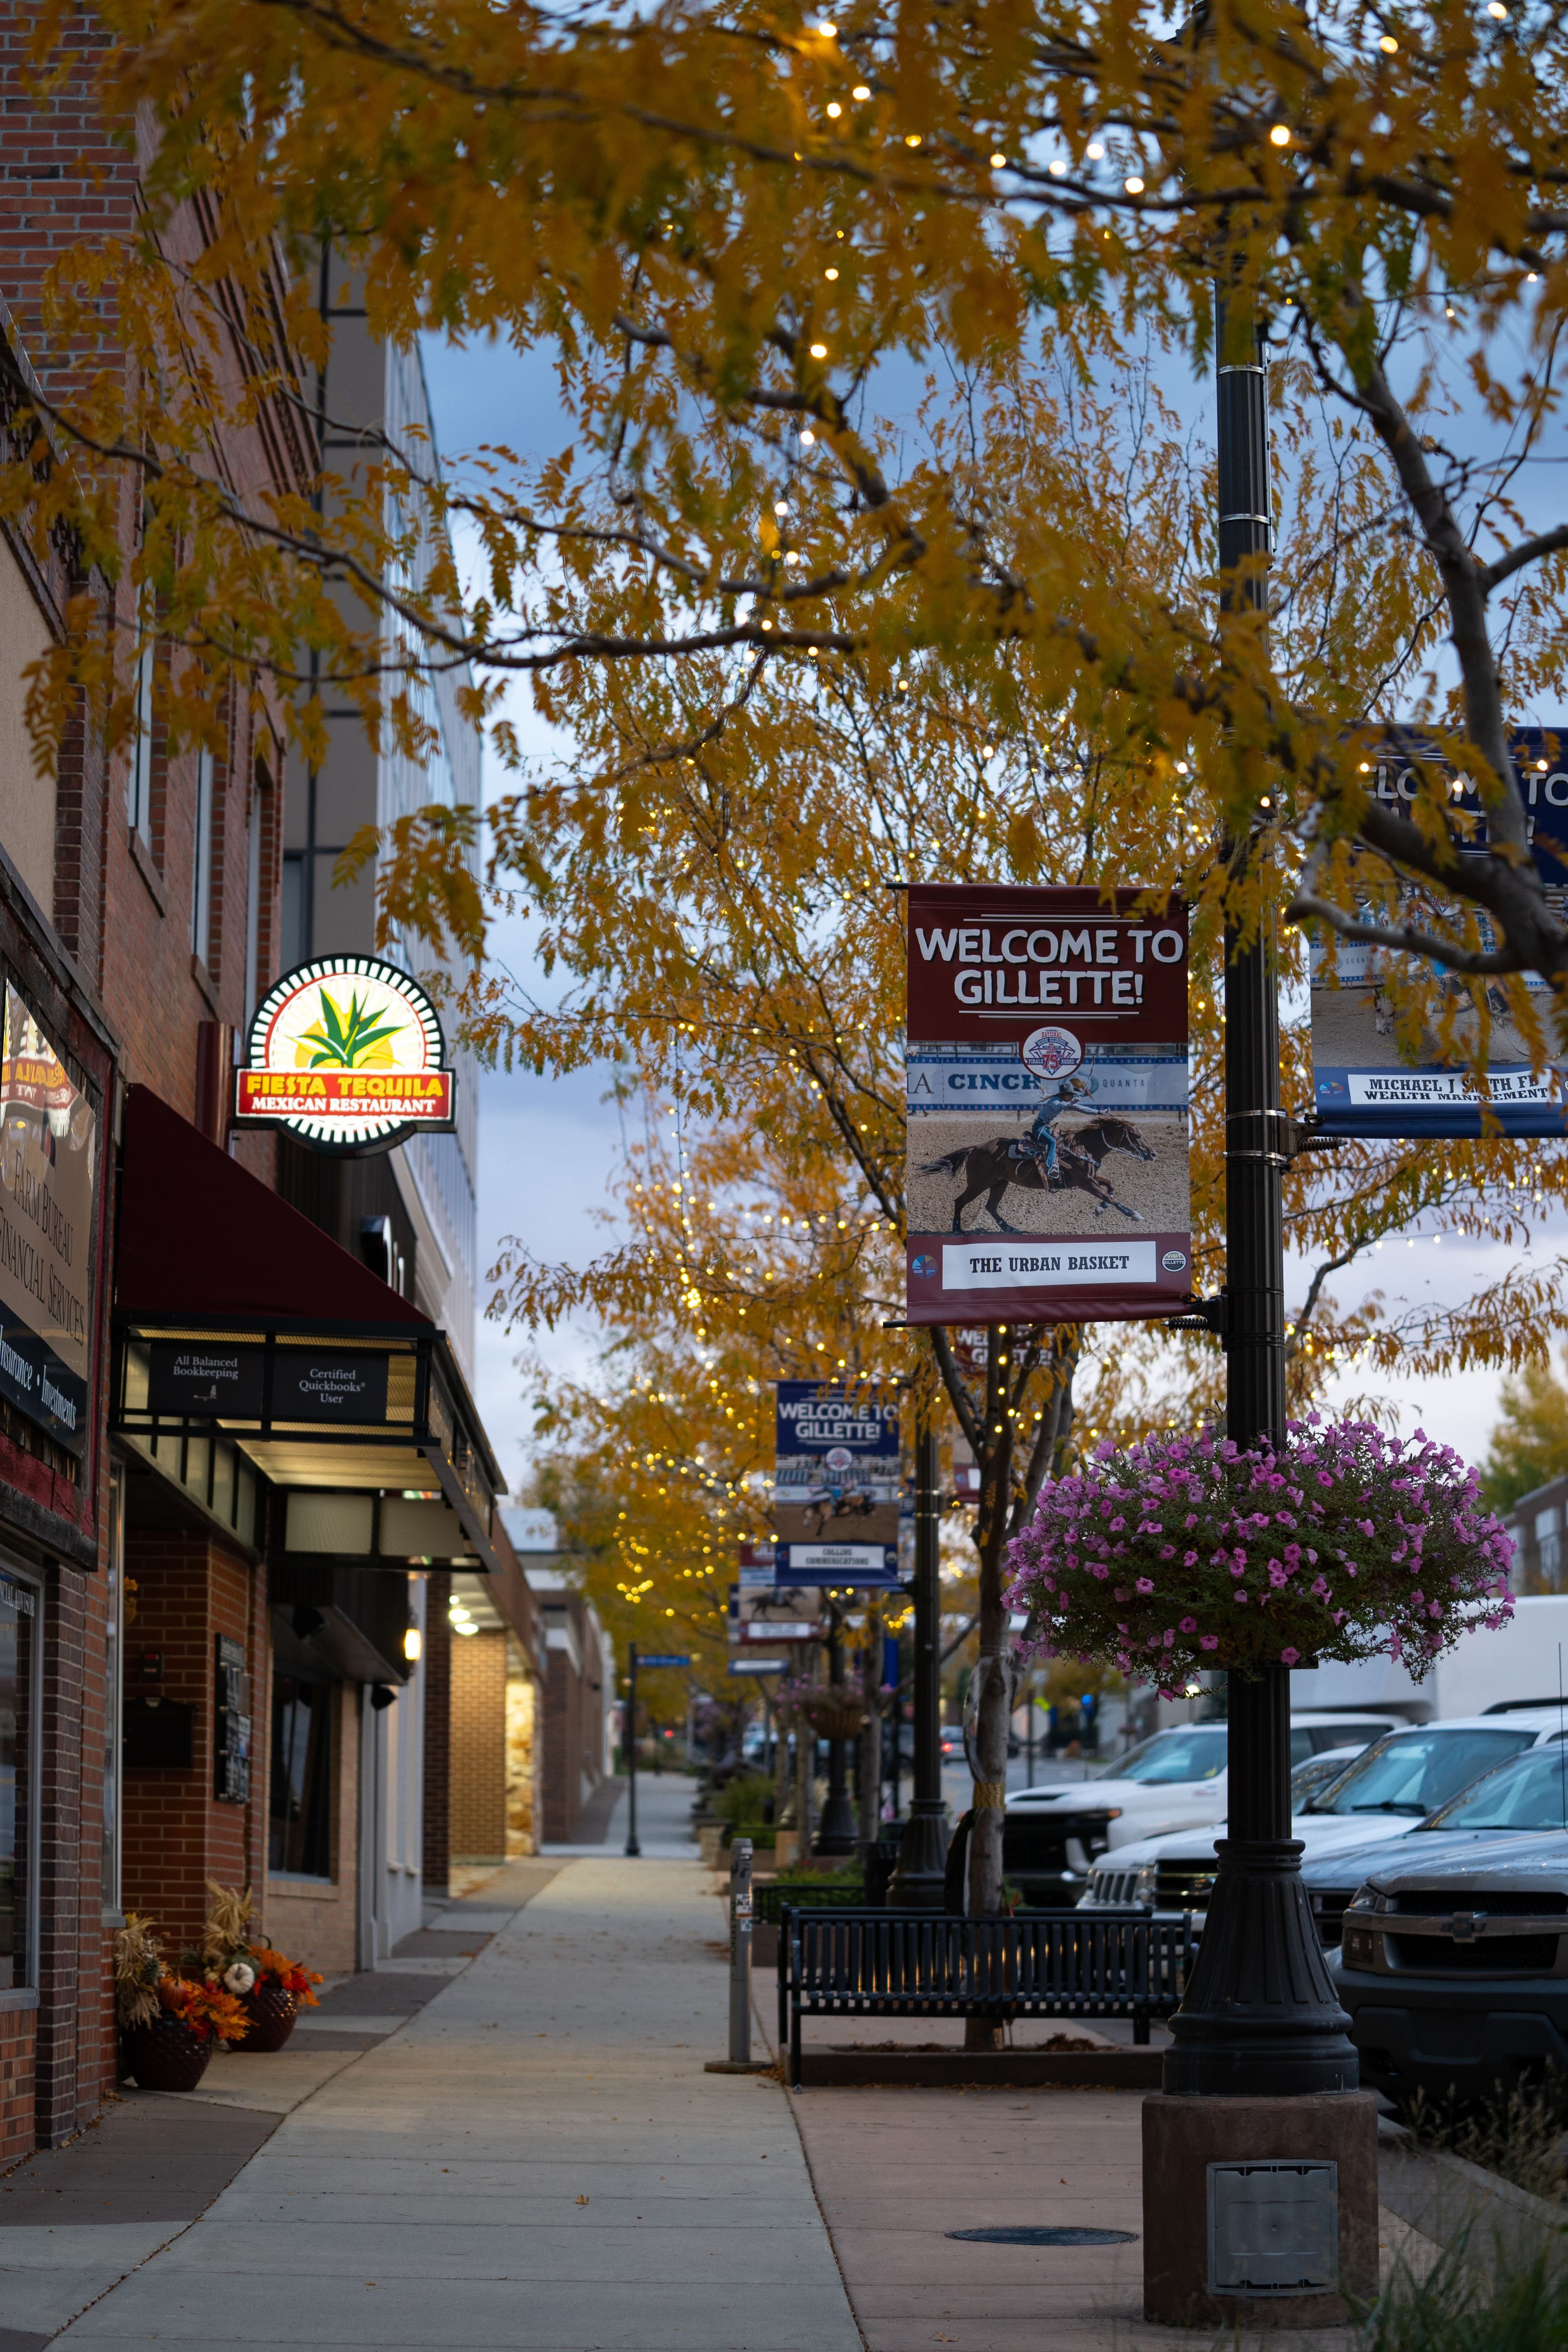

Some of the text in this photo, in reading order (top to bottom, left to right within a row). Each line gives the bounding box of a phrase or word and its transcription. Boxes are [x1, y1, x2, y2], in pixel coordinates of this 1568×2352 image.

[1522, 771, 1568, 806] TO
[915, 928, 1183, 964] WELCOME TO
[954, 970, 1143, 1004] GILLETTE!
[1037, 1038, 1066, 1046] HIGH SCHOOL
[1042, 1054, 1058, 1069] 75
[247, 1075, 444, 1098] FIESTA TEQUILA
[948, 1074, 1041, 1089] CINCH
[1103, 1079, 1145, 1088] QUANTA
[1369, 1078, 1443, 1092] MICHAEL
[1448, 1078, 1456, 1094] J
[1364, 1087, 1548, 1102] WEALTH MANAGEMENT
[251, 1096, 436, 1113] MEXICAN RESTAURANT
[13, 1149, 74, 1267] FARM BUREAU
[970, 1256, 1129, 1274] THE URBAN BASKET
[48, 1263, 85, 1347] SERVICES
[175, 1355, 238, 1368] All Balanced
[0, 1324, 76, 1430] Insurance Investments
[173, 1366, 239, 1379] Bookkeeping
[310, 1368, 356, 1379] Certified
[320, 1393, 344, 1404] User
[779, 1403, 870, 1421] WELCOME
[795, 1421, 881, 1439] GILLETTE!
